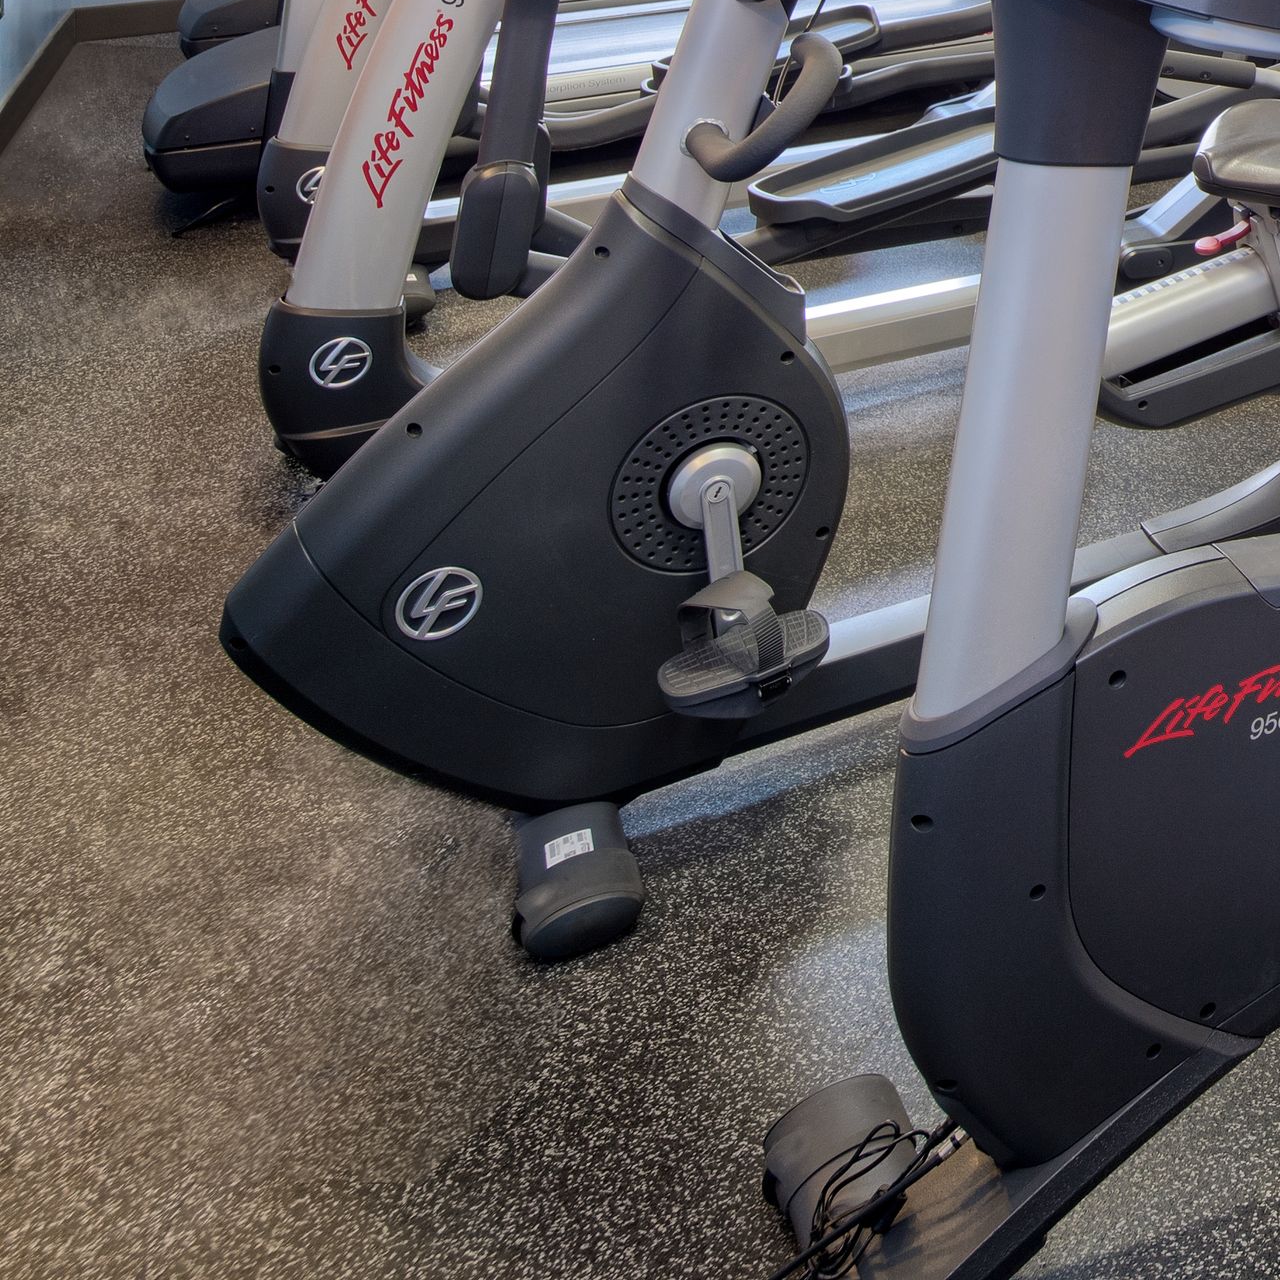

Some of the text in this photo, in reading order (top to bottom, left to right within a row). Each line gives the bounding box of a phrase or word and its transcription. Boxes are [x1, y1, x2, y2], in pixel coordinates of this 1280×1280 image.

[335, 11, 368, 70] Life
[362, 129, 404, 209] Life
[387, 13, 454, 138] Fitness
[1124, 684, 1229, 758] Life
